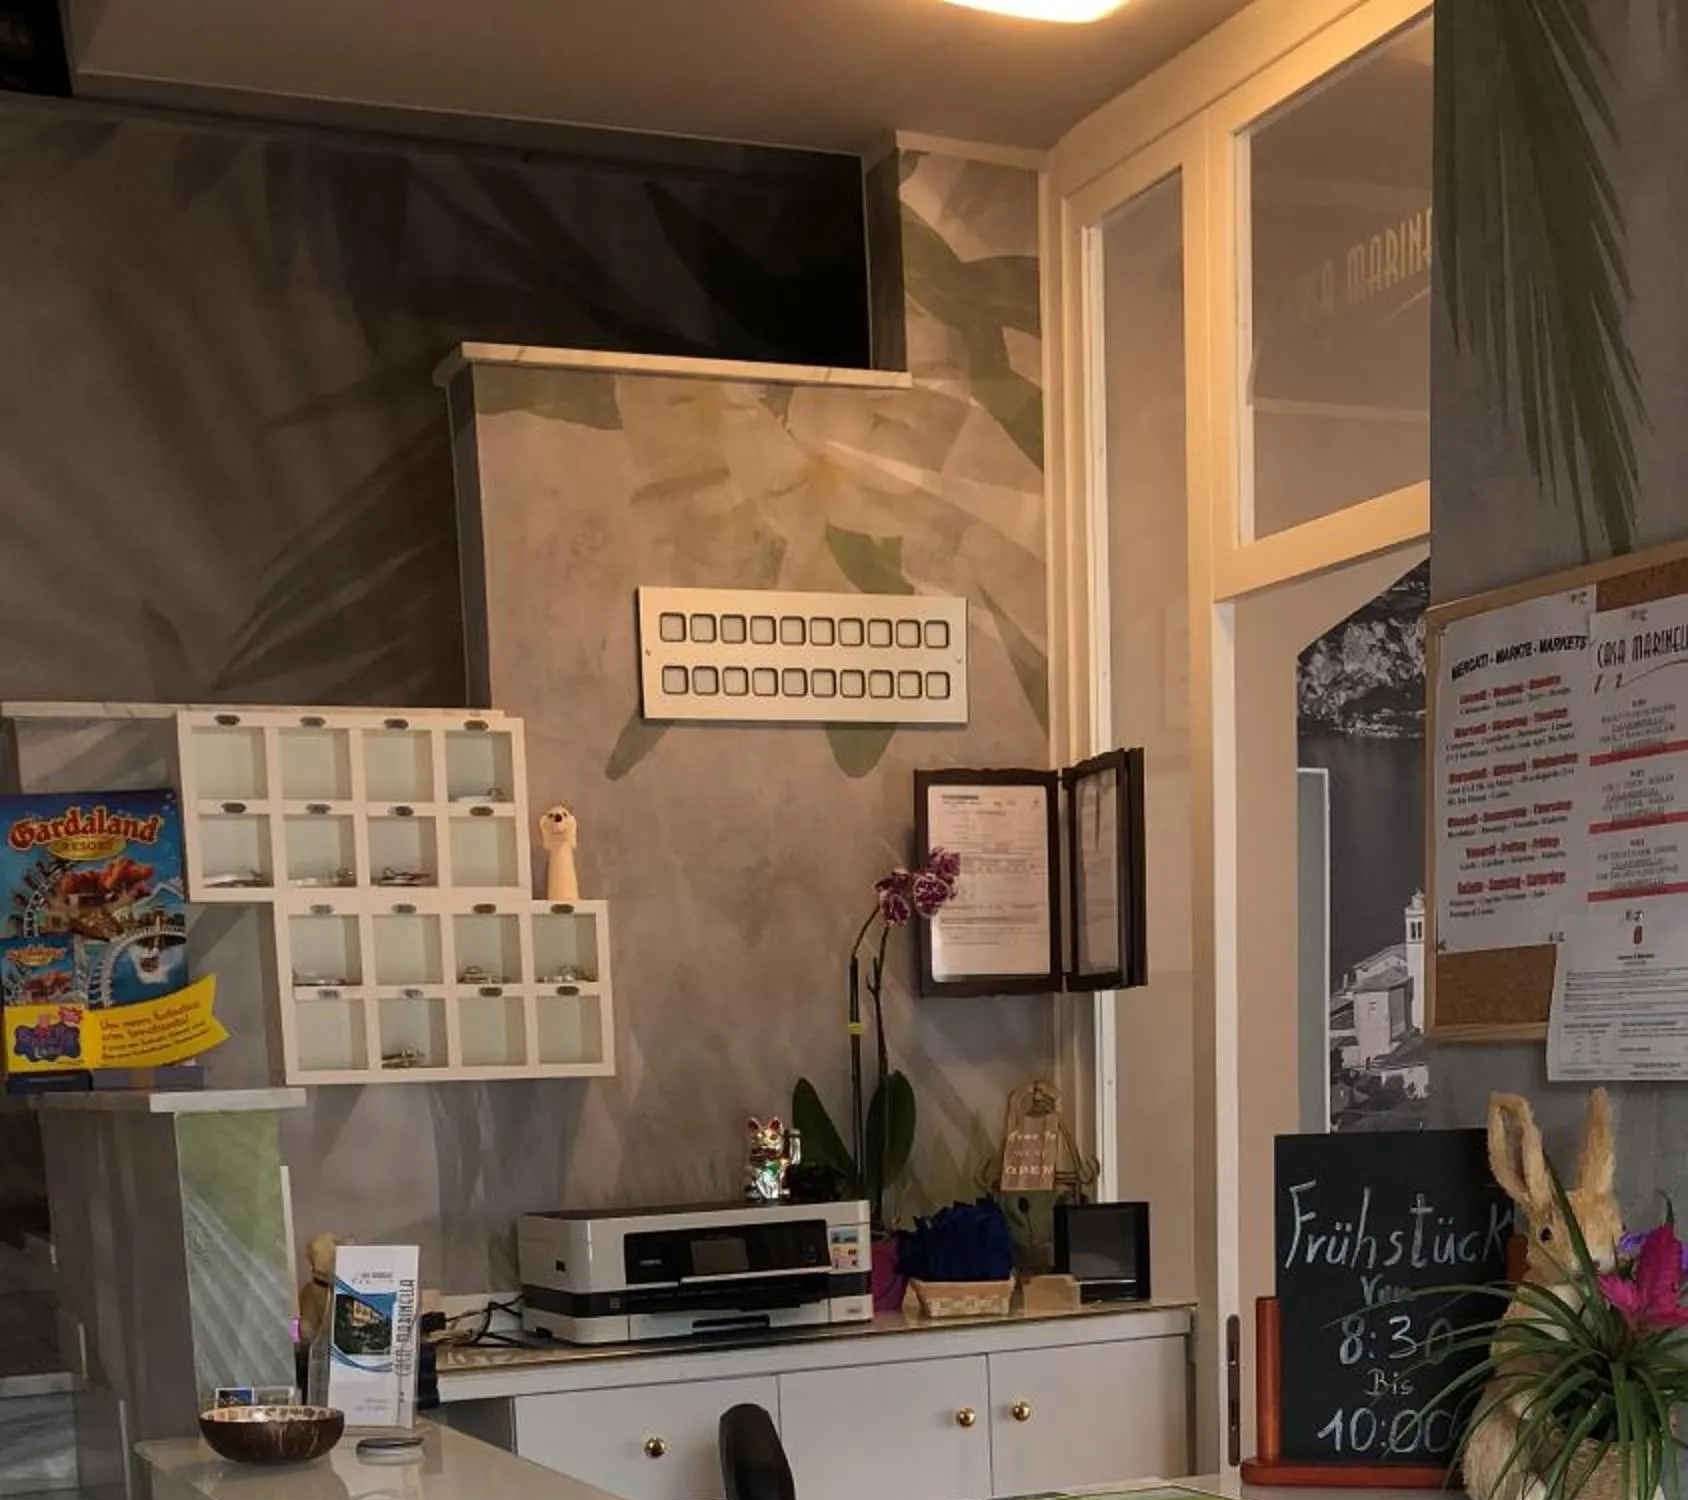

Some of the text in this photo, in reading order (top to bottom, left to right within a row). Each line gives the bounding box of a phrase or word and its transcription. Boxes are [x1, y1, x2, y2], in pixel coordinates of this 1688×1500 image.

[8, 805, 162, 850] Gardaland
[1005, 1164, 1055, 1175] OPEN
[1363, 1368, 1415, 1397] Bis
[1317, 1406, 1462, 1453] 10:00
